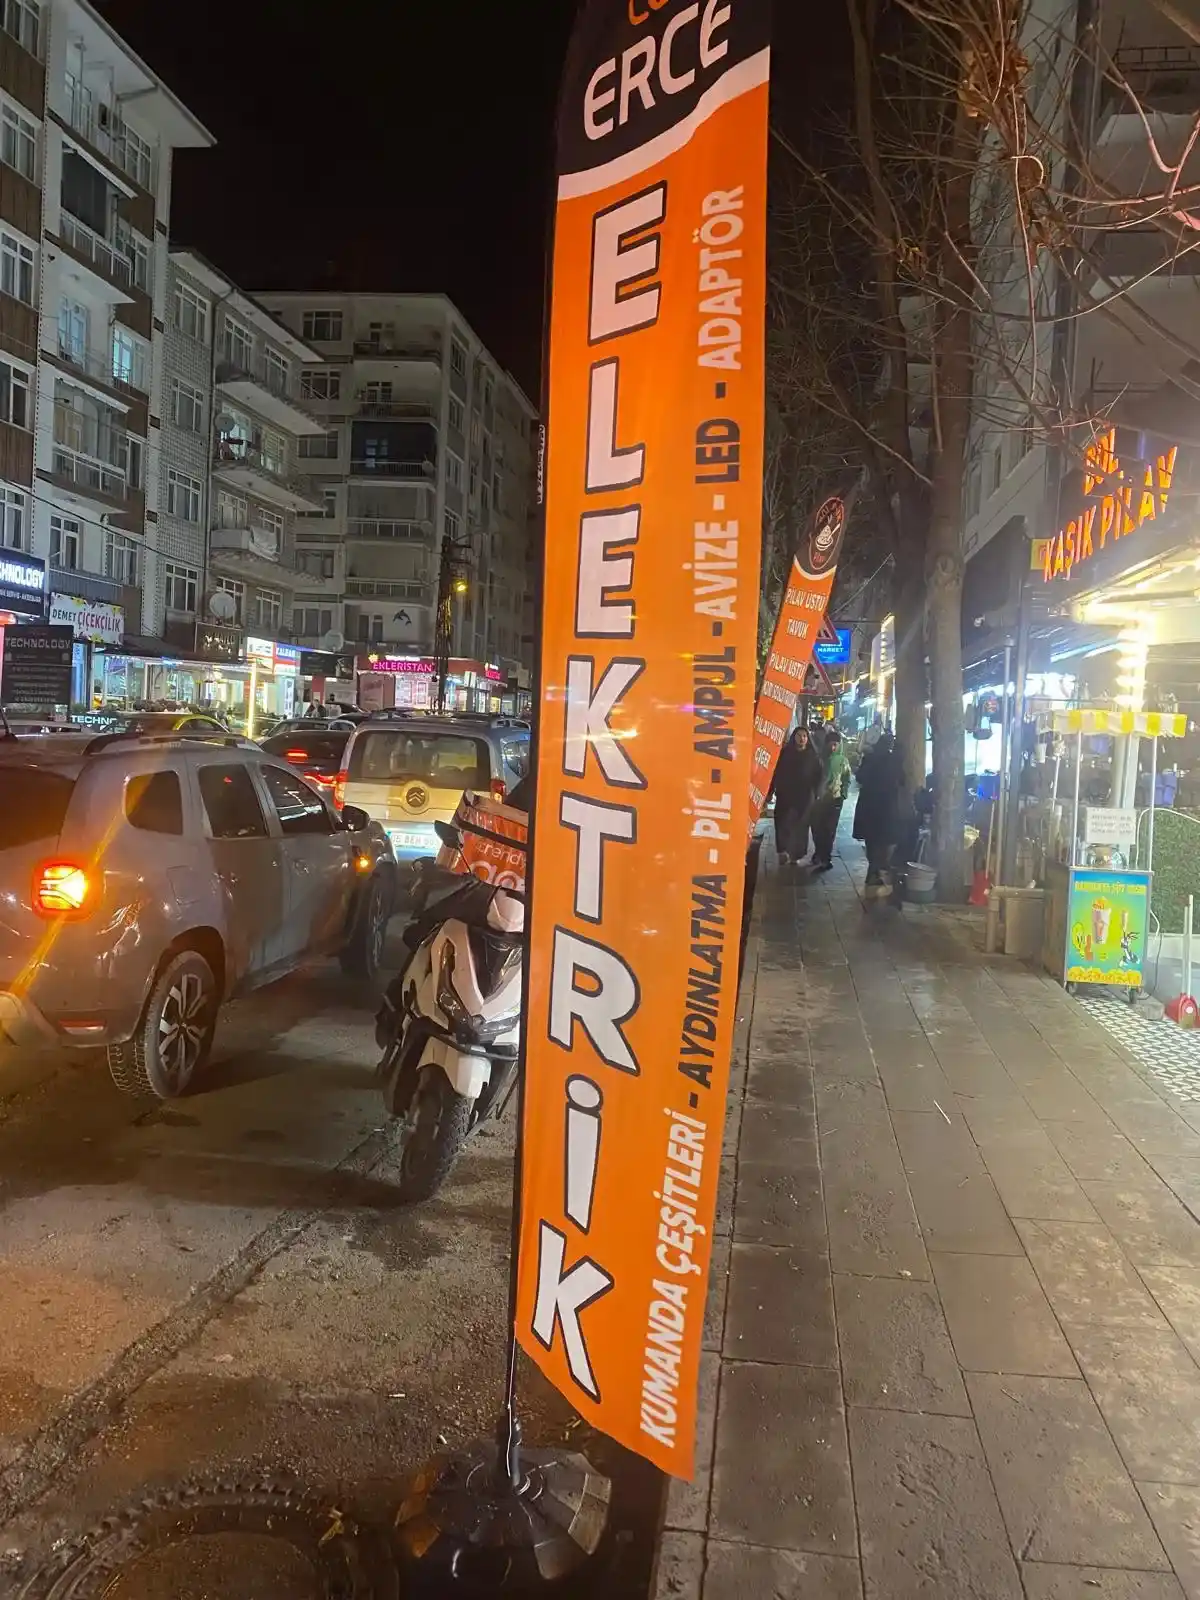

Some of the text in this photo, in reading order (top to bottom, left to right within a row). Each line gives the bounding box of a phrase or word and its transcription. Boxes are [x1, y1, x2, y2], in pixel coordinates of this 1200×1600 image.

[583, 0, 732, 141] ERCE
[691, 184, 745, 370] ADAPTÖR
[695, 417, 741, 484] LED
[52, 608, 121, 634] DEMET ÇİÇEKÇİLİK
[681, 519, 739, 620] AVİZE
[5, 637, 72, 650] TECHNOLOGY
[692, 646, 738, 762] AMPUL
[681, 792, 732, 841] PİL
[677, 874, 728, 1090] AYDINLATMA
[653, 1107, 708, 1277] ÇEŞİTLERİ
[639, 1278, 689, 1449] KUMANDA
